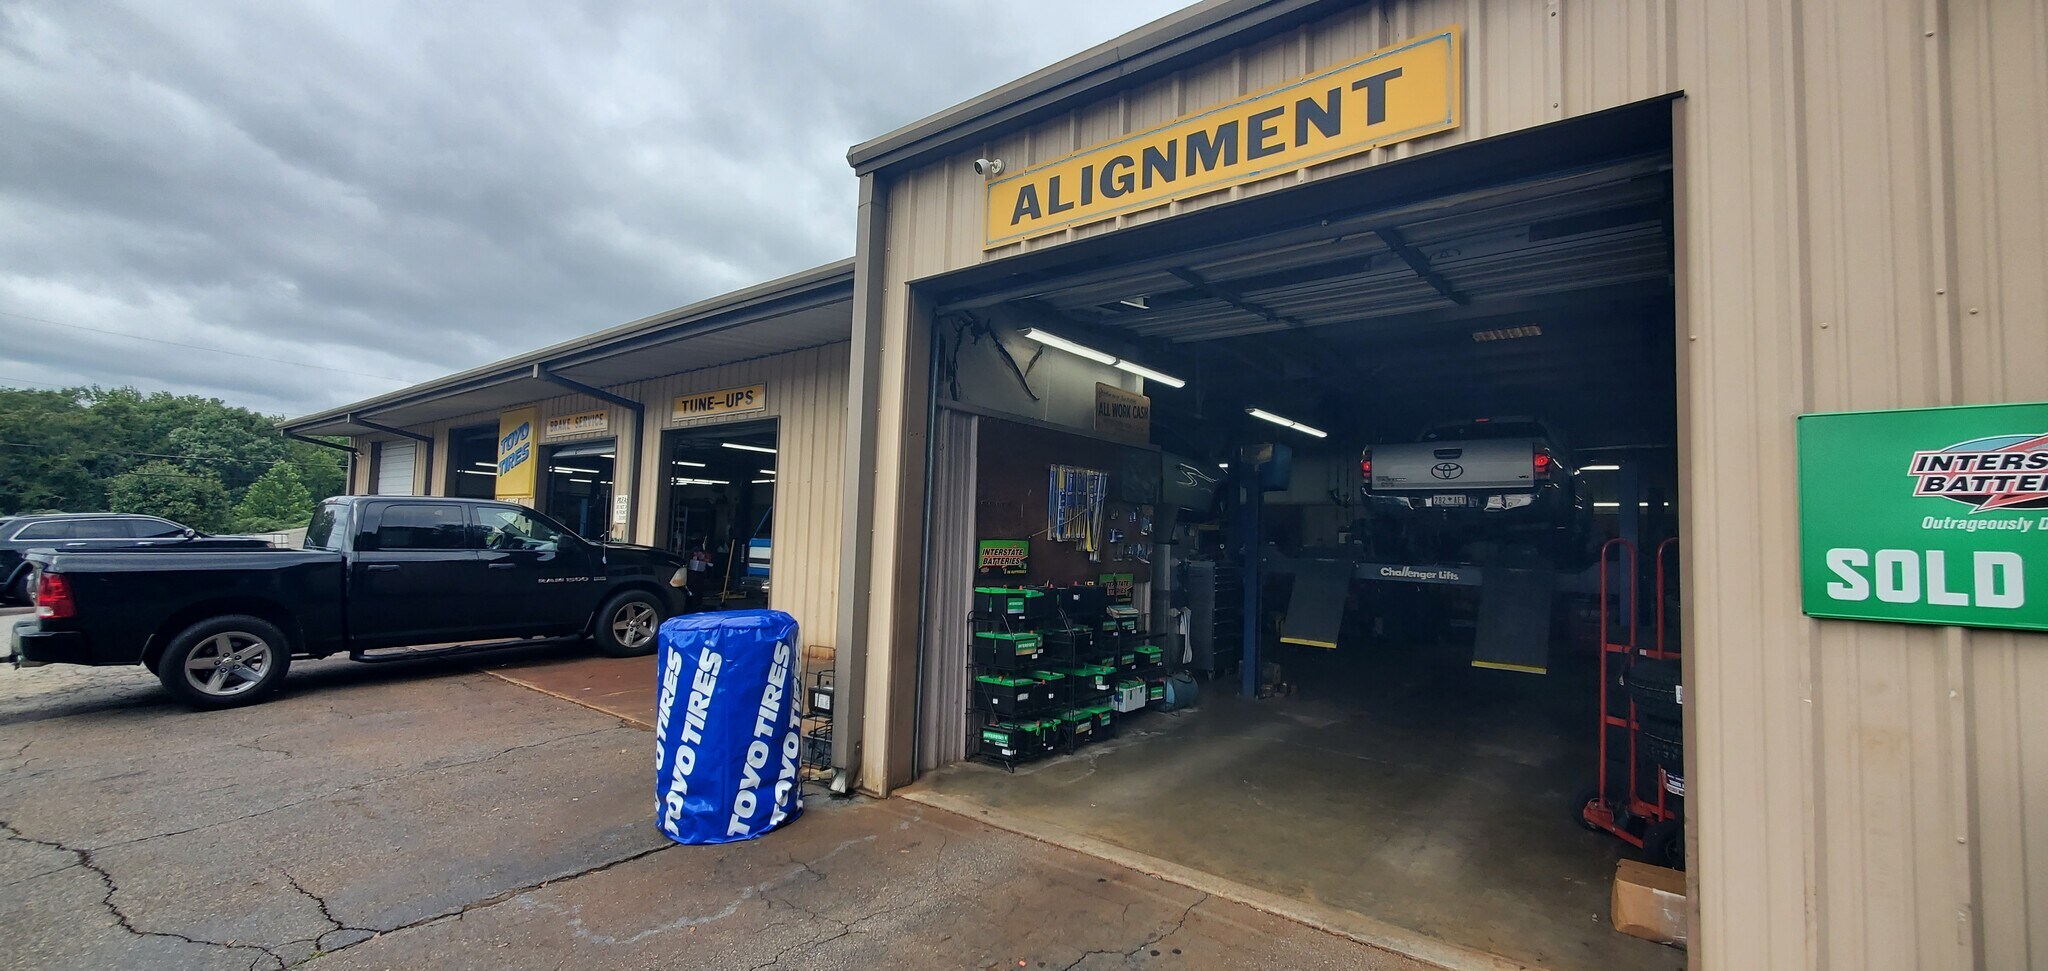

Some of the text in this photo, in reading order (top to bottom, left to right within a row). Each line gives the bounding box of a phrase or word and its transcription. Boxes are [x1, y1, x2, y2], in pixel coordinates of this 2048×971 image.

[1010, 66, 1403, 227] ALIGNMENT
[682, 389, 754, 413] TUNE-UPS
[1098, 402, 1149, 419] ALL WORK CASH
[550, 413, 604, 432] BRAKE SERVICE
[500, 421, 530, 455] TOYO
[498, 442, 530, 477] TIRES
[1916, 452, 2048, 472] INTERS
[1921, 516, 2034, 532] Outrageously
[982, 548, 1024, 556] INTERSTATE
[983, 557, 1020, 565] BATTERIES
[1380, 566, 1459, 581] Challenger Lifts
[1826, 547, 2025, 609] SOLD
[664, 646, 723, 837] TOYO TIRES
[726, 640, 790, 837] TOYO TIRES
[770, 731, 800, 826] TOYO
